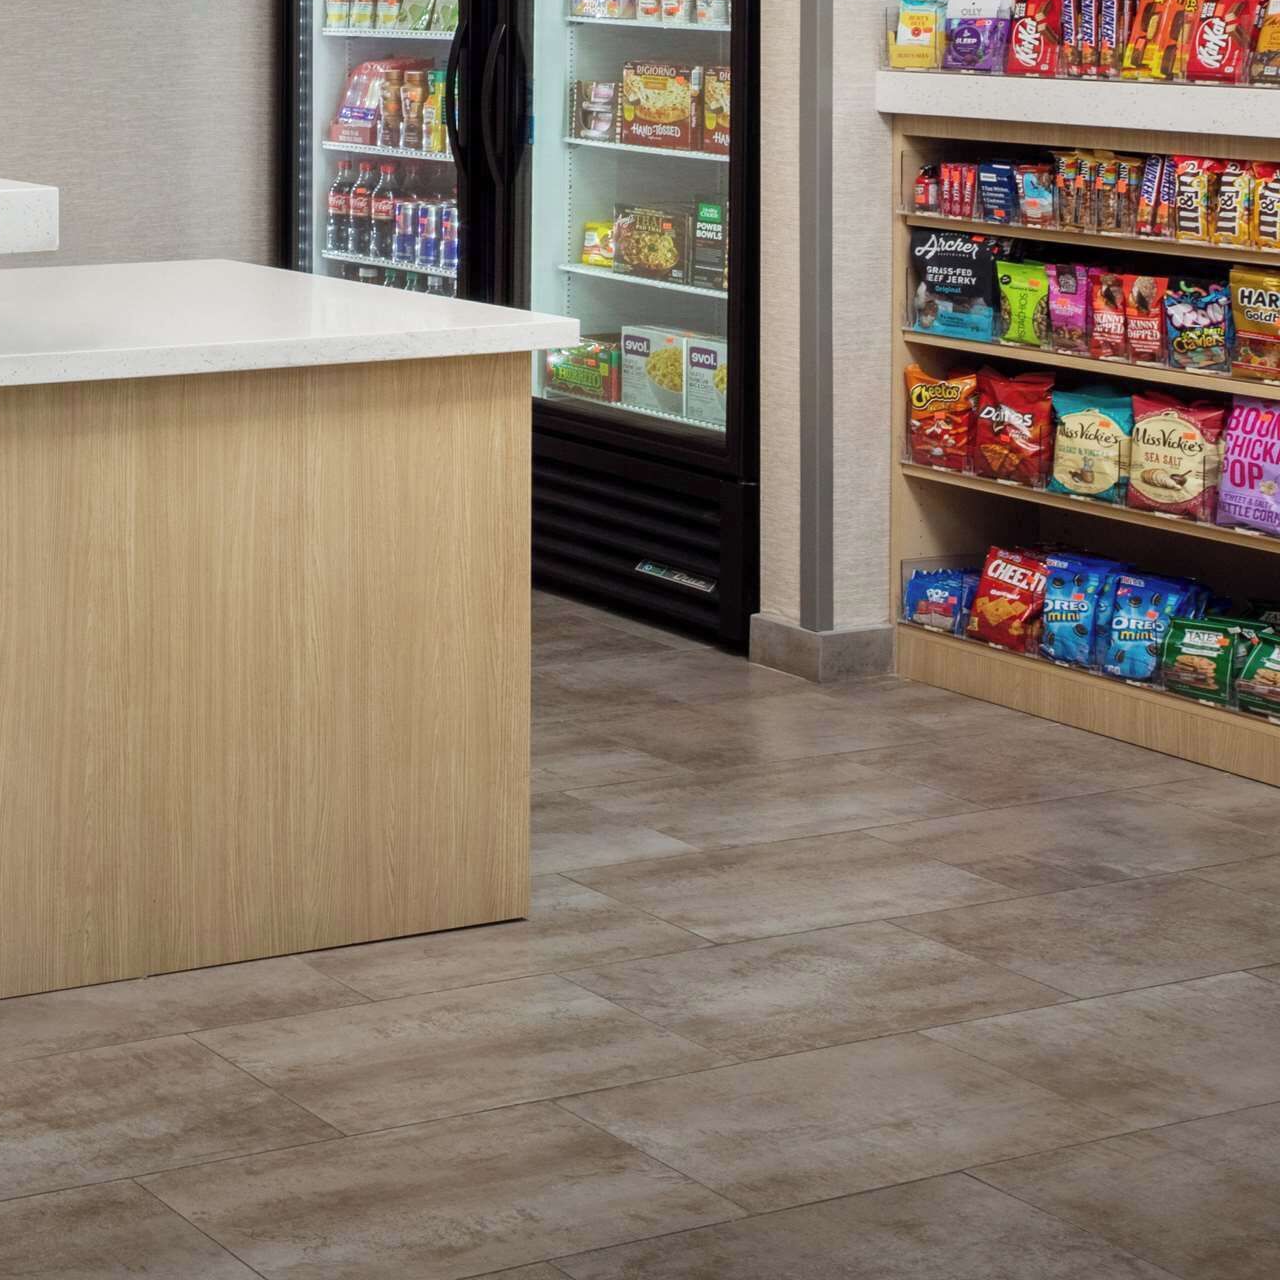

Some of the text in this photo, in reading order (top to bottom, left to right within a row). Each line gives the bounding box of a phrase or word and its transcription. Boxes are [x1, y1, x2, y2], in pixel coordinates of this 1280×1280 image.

[961, 8, 982, 16] OLLY
[696, 222, 722, 232] POWER
[696, 230, 722, 240] BOWLS
[915, 234, 979, 259] Archer
[946, 276, 977, 285] JERKY
[1128, 319, 1159, 330] KINNY
[911, 383, 960, 407] Cheetos
[1078, 422, 1120, 448] Vickie's
[1132, 427, 1204, 456] Miss Vickie's
[1144, 452, 1184, 468] SEA SALT
[1043, 599, 1088, 612] OREO
[1112, 616, 1165, 632] OREO
[1186, 630, 1222, 642] TATE
